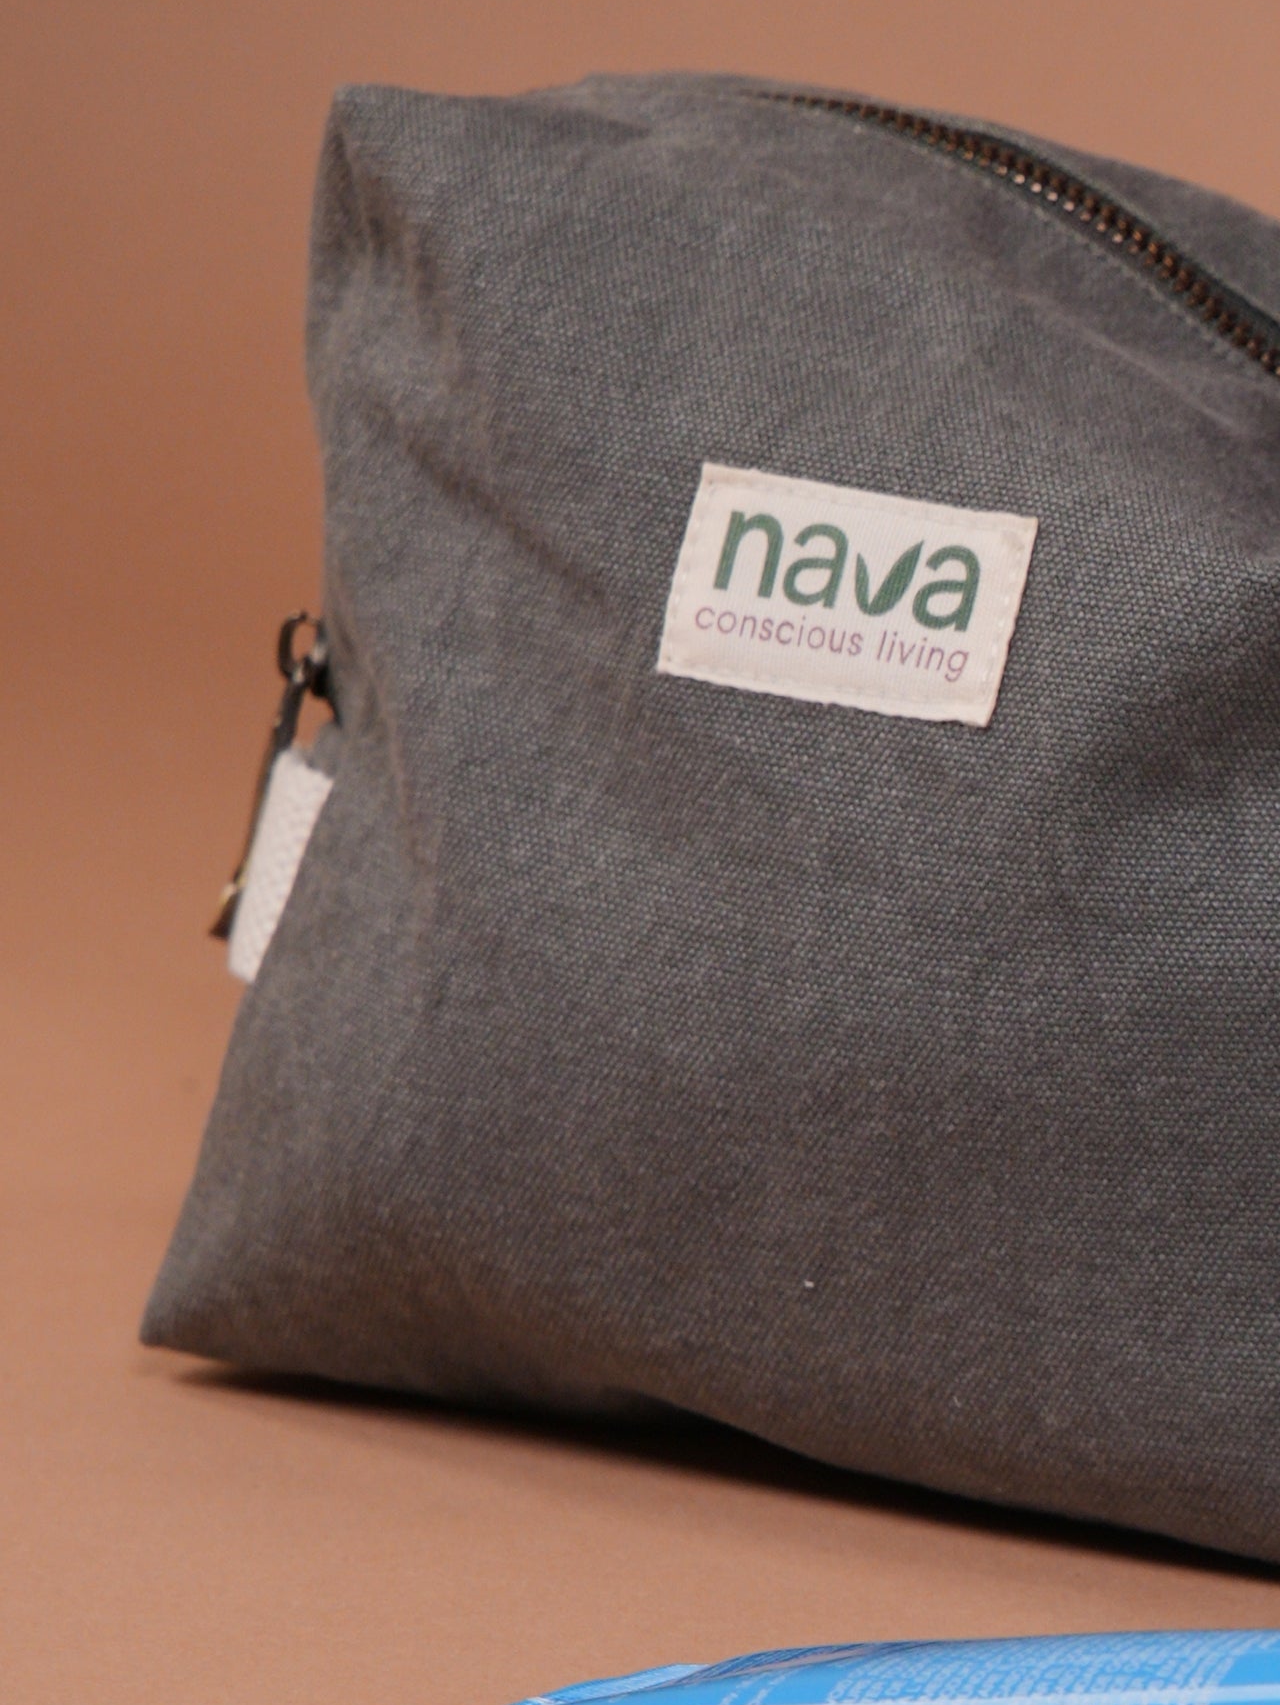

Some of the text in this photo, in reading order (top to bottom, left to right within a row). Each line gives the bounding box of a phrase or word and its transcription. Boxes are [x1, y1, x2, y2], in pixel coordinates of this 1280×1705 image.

[714, 510, 980, 632] nava
[695, 605, 969, 682] conscious living
